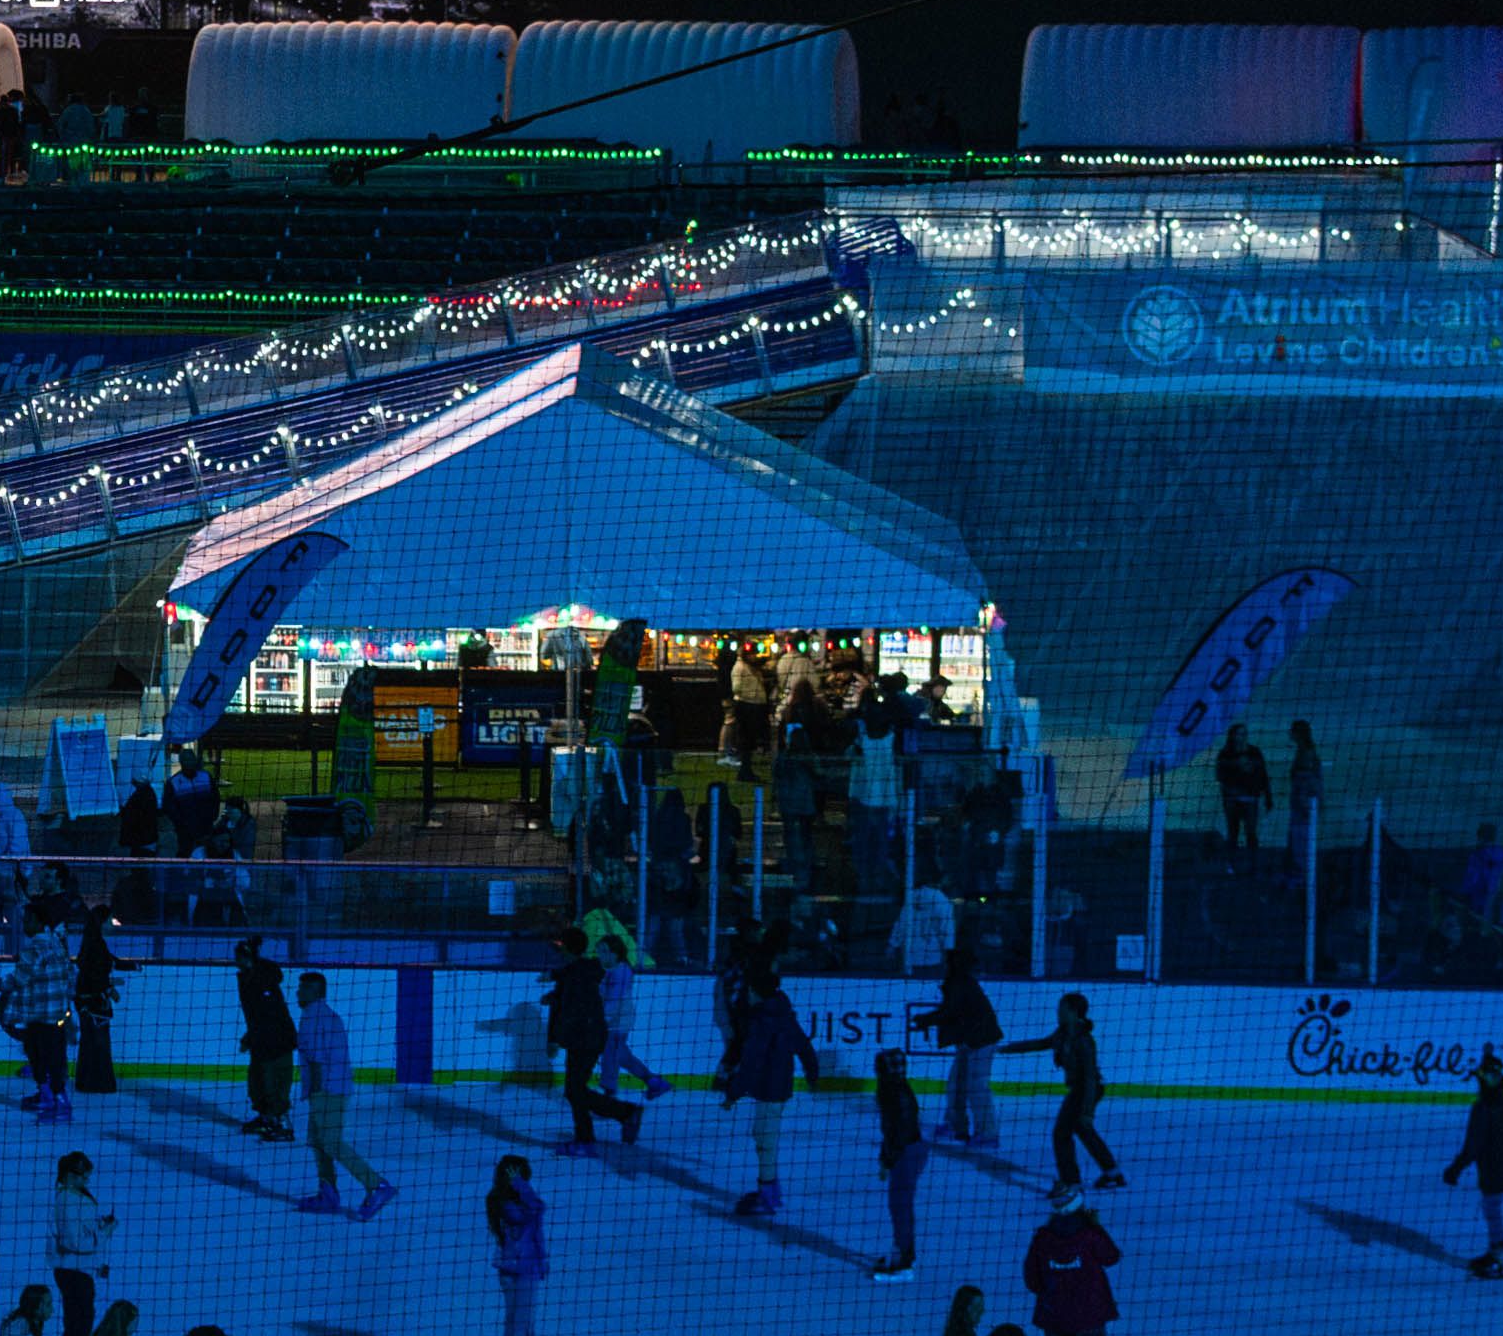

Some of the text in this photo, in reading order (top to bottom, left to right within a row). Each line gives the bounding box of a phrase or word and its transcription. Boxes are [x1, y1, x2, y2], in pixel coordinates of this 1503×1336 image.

[17, 33, 82, 49] SHIBA
[1217, 288, 1369, 326] Atrium
[1215, 335, 1328, 364] Levine
[190, 542, 308, 708] FOOD
[1177, 574, 1314, 737] FOOD
